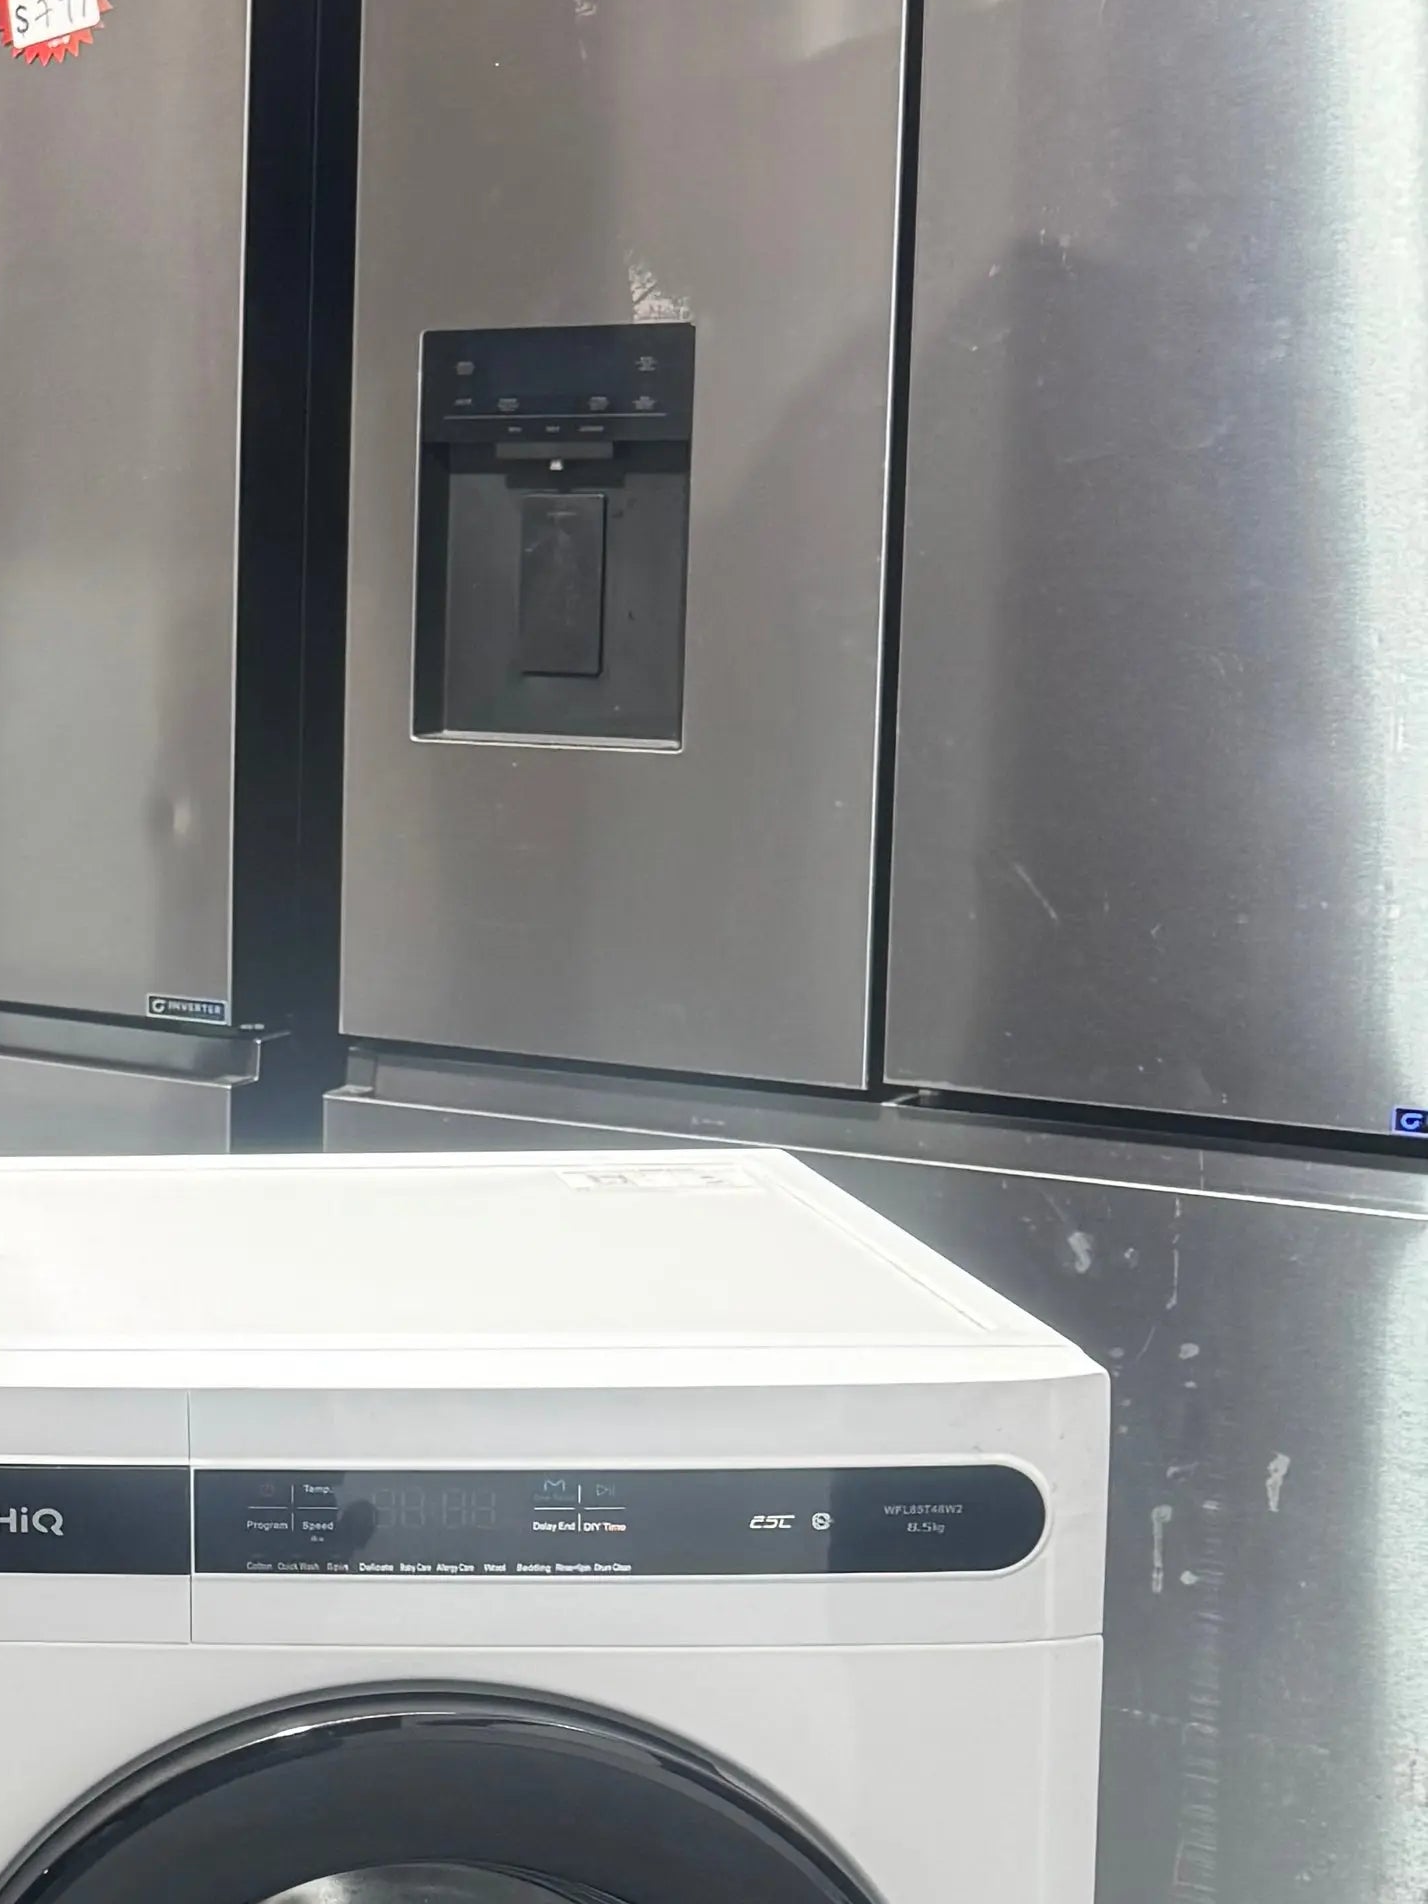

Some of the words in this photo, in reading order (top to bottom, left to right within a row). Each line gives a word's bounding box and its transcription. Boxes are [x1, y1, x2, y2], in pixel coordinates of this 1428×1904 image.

[247, 1521, 289, 1531] Program
[302, 1521, 334, 1531] Speed
[533, 1521, 557, 1532] Delay
[558, 1521, 576, 1531] End
[583, 1522, 601, 1531] DIY
[603, 1522, 626, 1531] Time
